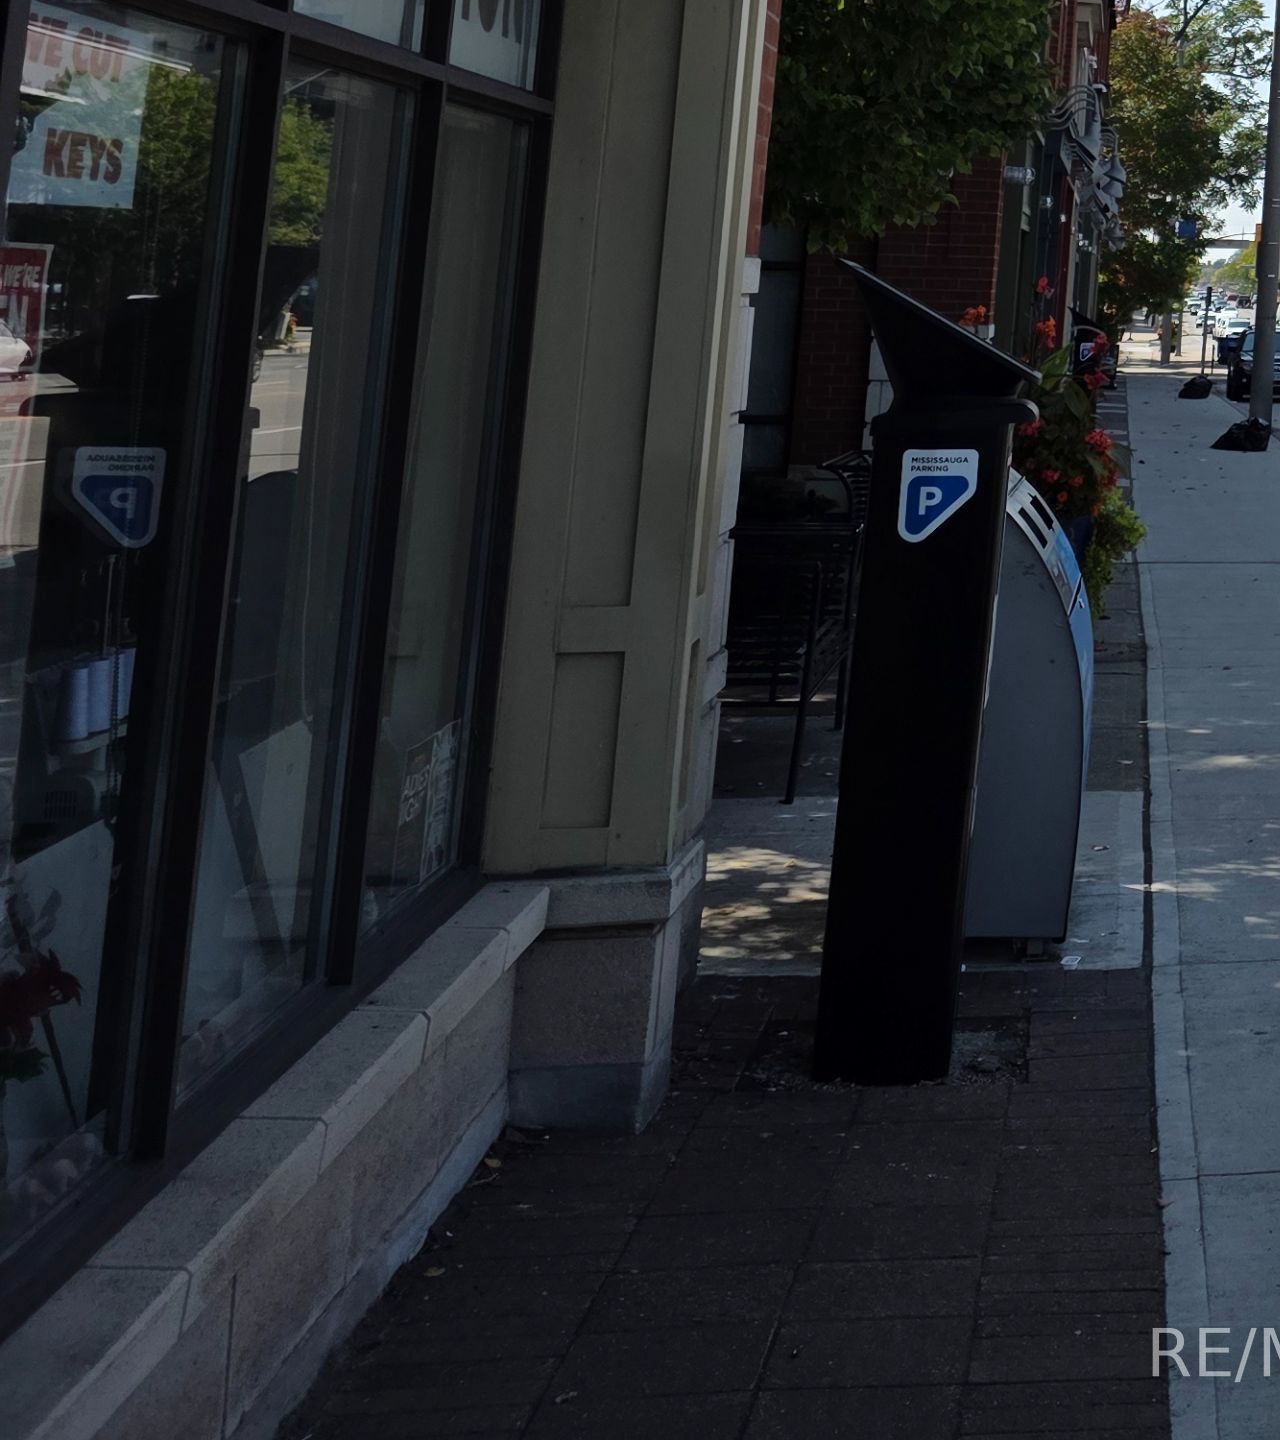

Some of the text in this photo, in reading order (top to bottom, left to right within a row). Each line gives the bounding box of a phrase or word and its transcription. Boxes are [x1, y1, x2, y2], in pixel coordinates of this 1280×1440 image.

[72, 25, 130, 84] CUT
[42, 127, 124, 185] KEYS
[910, 465, 949, 473] PARKING
[911, 456, 969, 464] MISSISSAUGA
[918, 486, 943, 515] P
